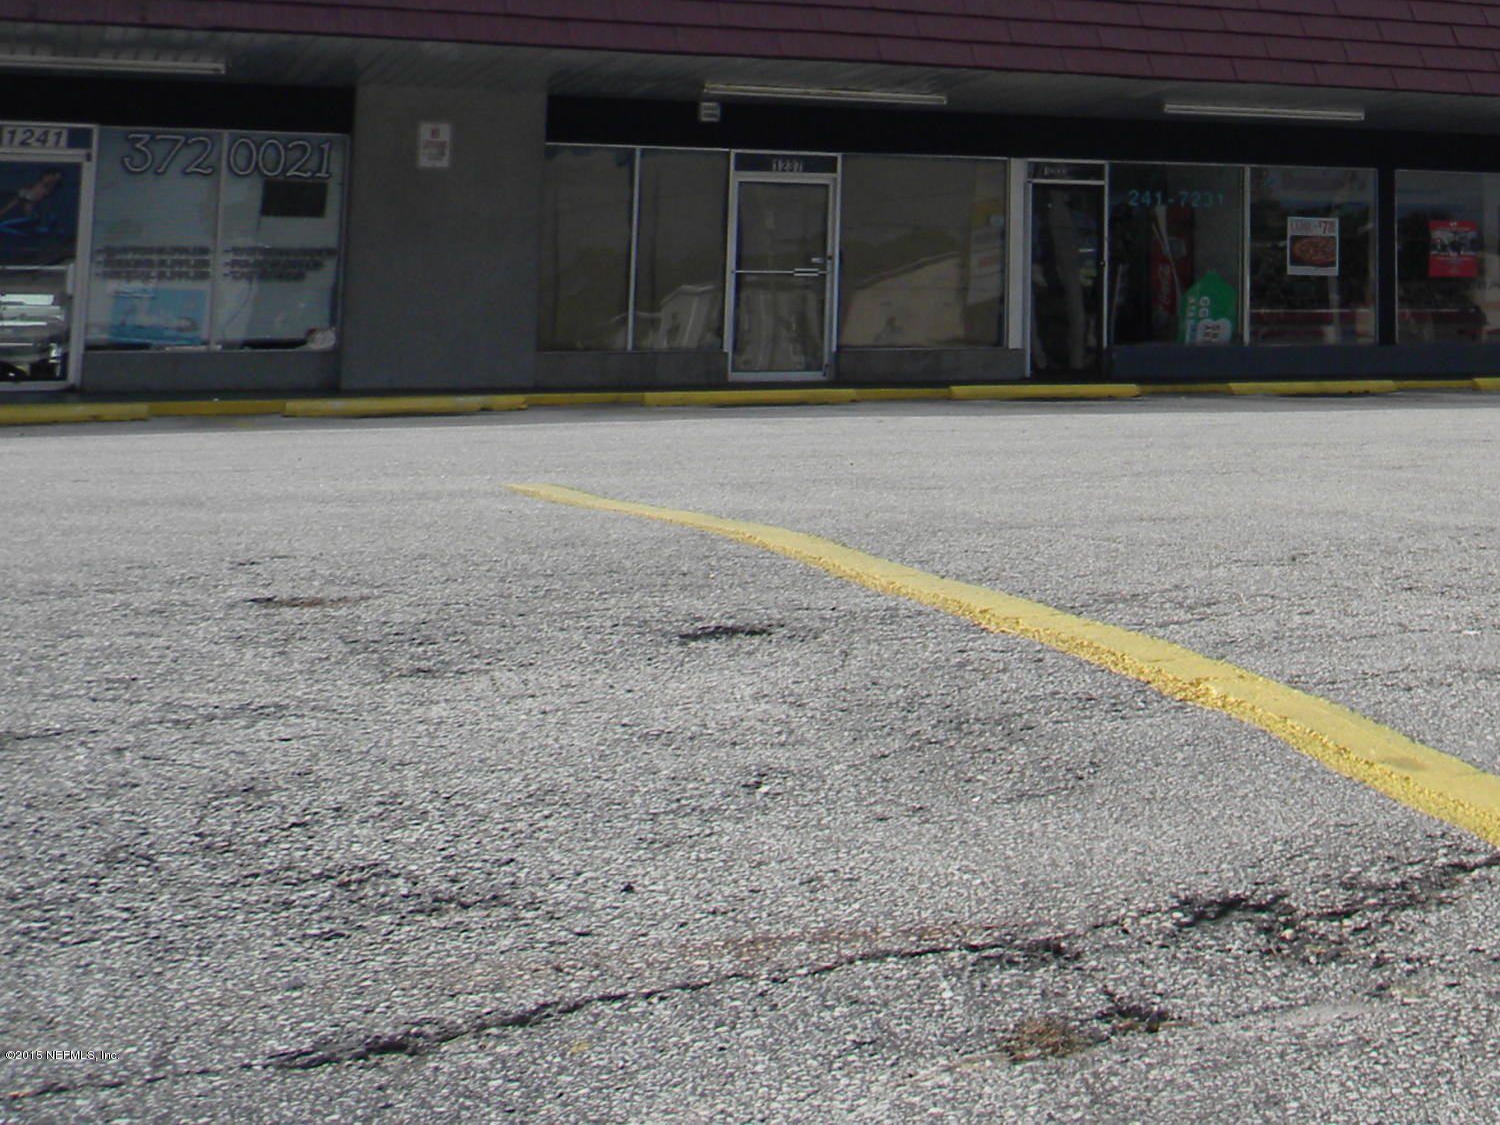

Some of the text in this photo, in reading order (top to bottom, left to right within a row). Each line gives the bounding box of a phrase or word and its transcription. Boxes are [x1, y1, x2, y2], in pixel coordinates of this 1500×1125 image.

[8, 128, 63, 147] 1241
[124, 133, 333, 178] 372 0021
